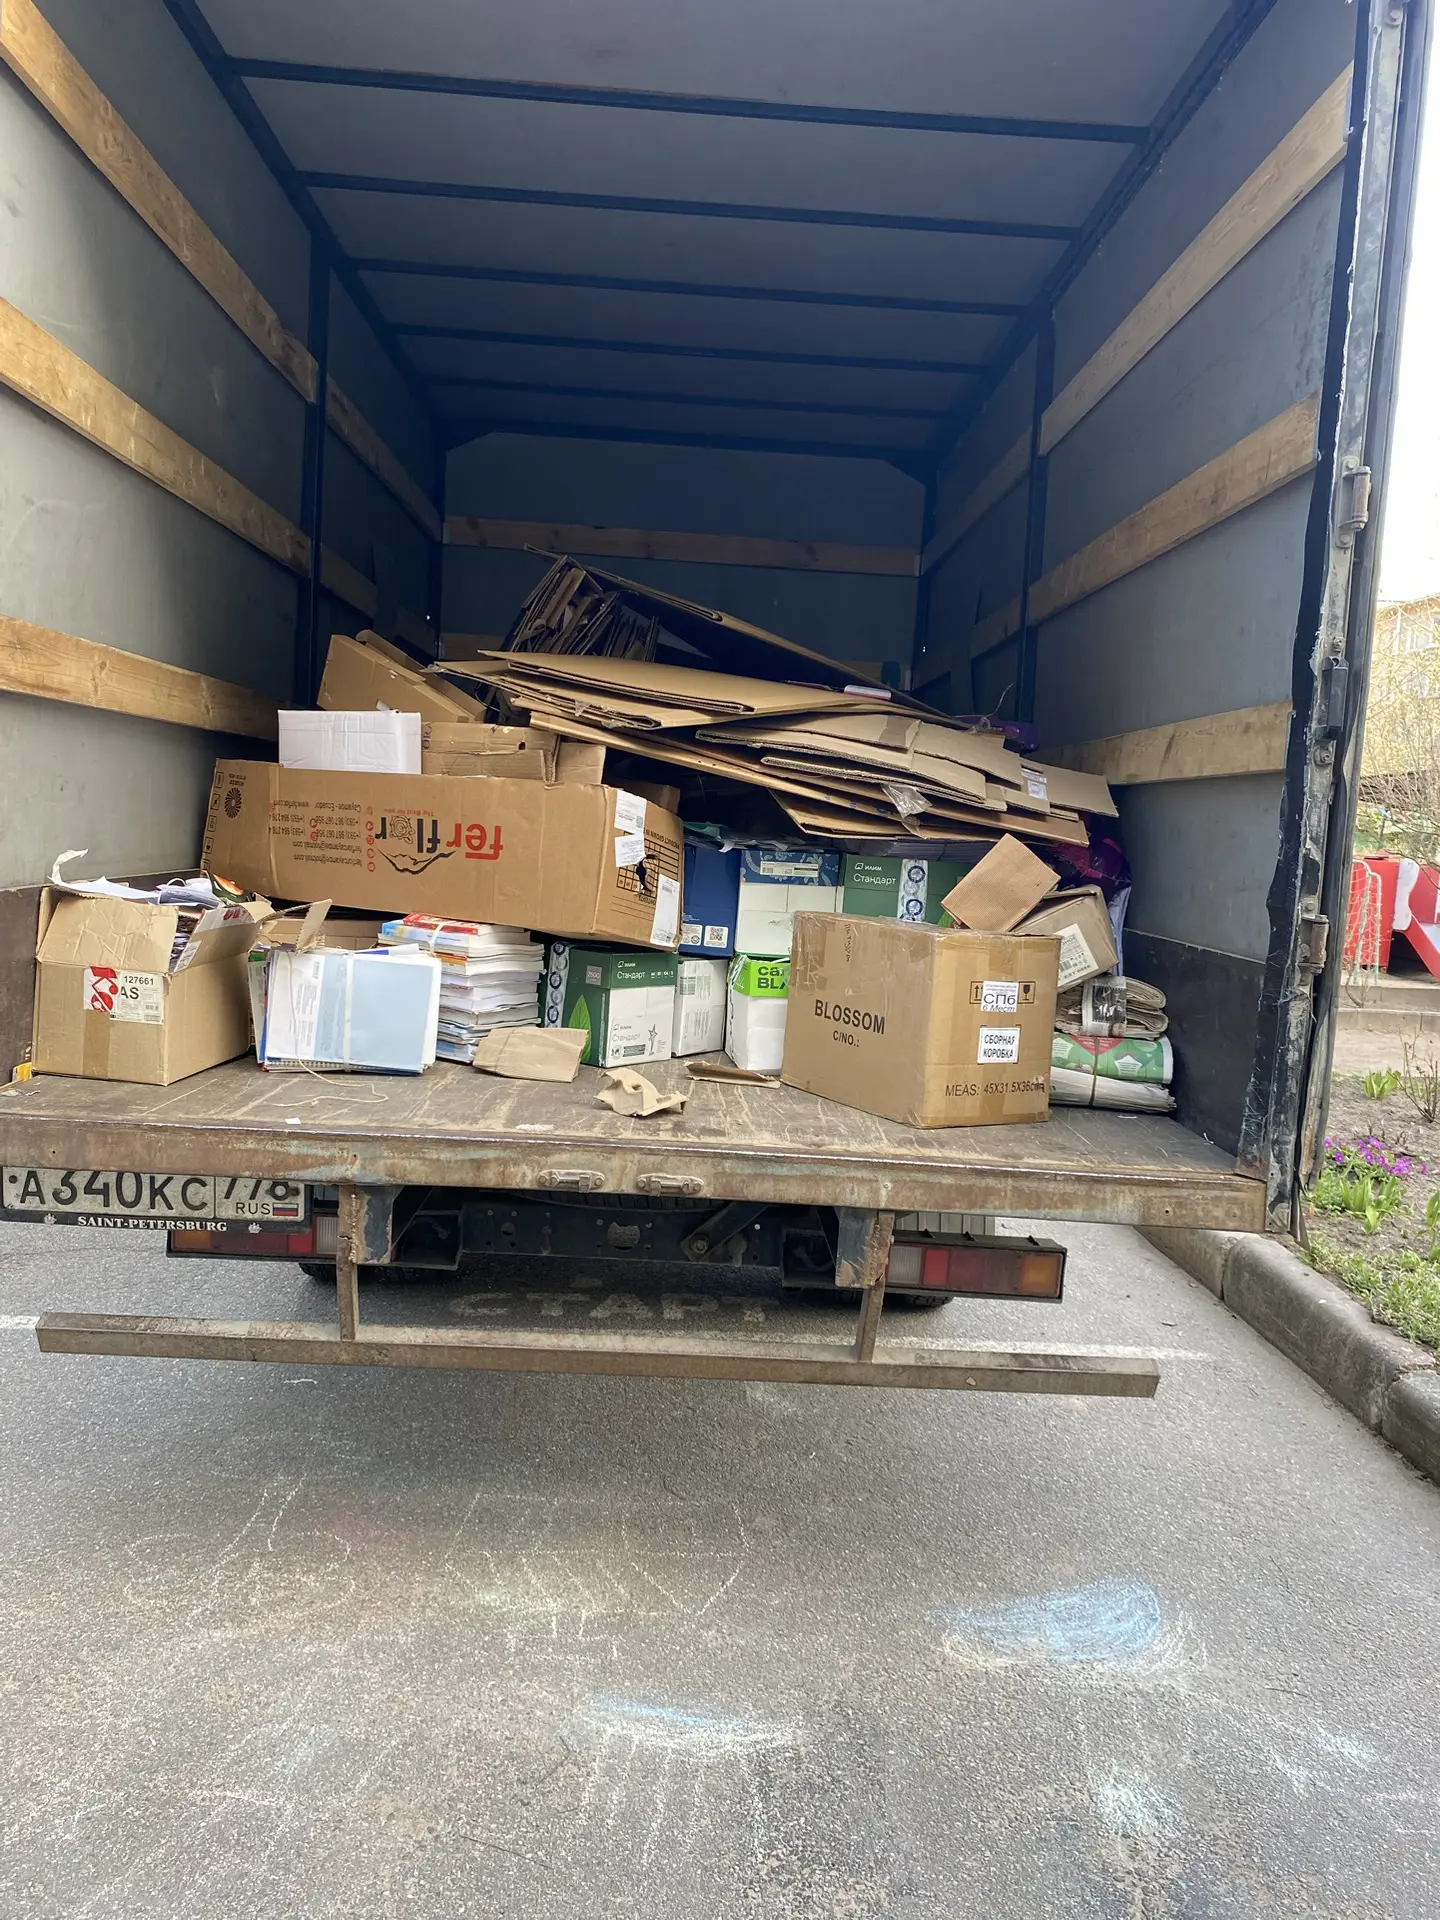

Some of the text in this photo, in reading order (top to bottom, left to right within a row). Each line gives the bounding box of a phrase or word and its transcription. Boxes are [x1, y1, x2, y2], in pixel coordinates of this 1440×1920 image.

[853, 872, 897, 886] Стандарт
[124, 975, 154, 986] 127661
[617, 971, 645, 980] Стандарт
[983, 993, 1016, 1005] СПб
[814, 999, 886, 1035] BLOSSOM
[984, 1034, 1015, 1045] СБОРНАЯ
[983, 1048, 1014, 1059] КОРОБКА
[945, 1084, 980, 1097] MEAS:
[235, 1201, 271, 1215] RUS
[78, 1216, 228, 1232] SAINT-PETERSBURG
